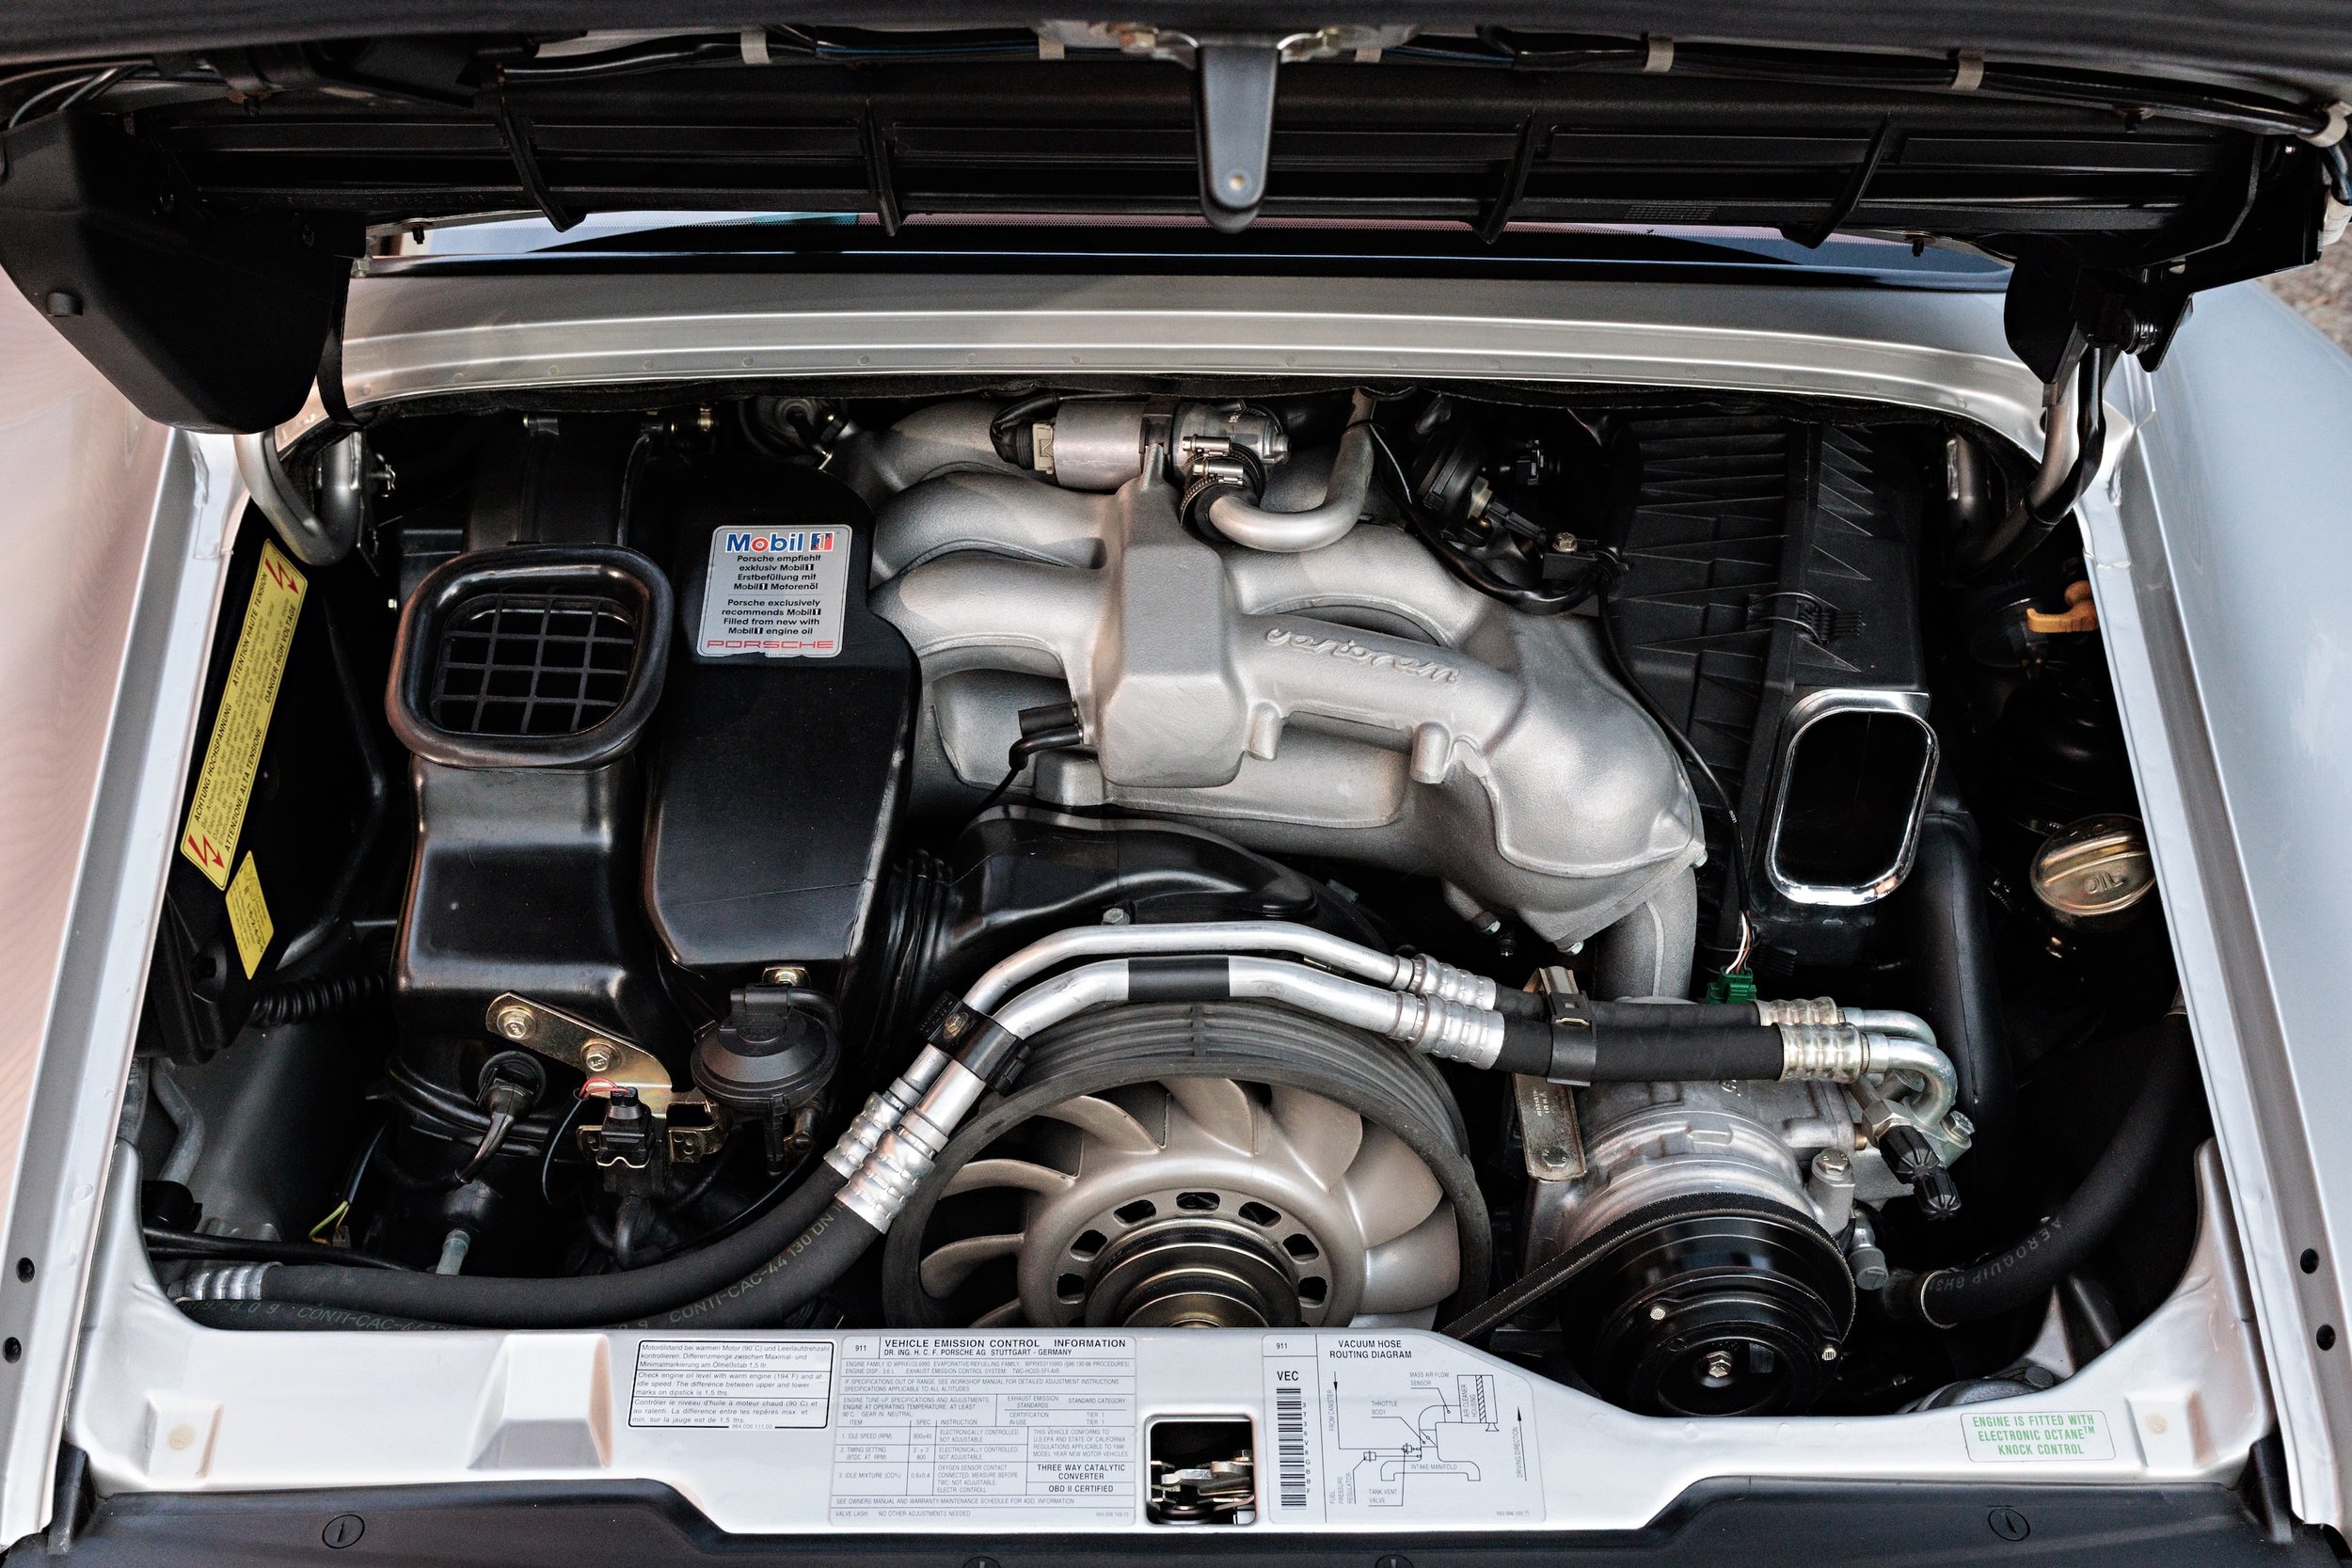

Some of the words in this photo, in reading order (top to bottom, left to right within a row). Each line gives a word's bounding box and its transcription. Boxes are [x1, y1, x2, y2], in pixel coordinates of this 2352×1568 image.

[725, 531, 804, 553] Mobil
[776, 555, 821, 564] empfiehlt
[768, 599, 820, 609] exclusively
[232, 638, 250, 688] ATTENTION
[246, 610, 258, 638] HAUTE
[254, 572, 268, 608] TENSION
[264, 666, 278, 704] DANGER
[275, 641, 285, 666] HIGH
[282, 604, 296, 642] VOLTAGE
[707, 641, 834, 649] PORSCHE
[1264, 628, 1460, 684] varioram
[194, 777, 211, 823] ACHTUNG
[207, 703, 232, 778] HOCHSPANNUNG
[225, 796, 244, 852] ATTENZIONE
[240, 771, 250, 795] ALTA
[246, 726, 262, 771] TENSIONE
[2084, 873, 2124, 895] OIL
[1973, 1216, 2062, 1285] AEROQUIP
[668, 1256, 788, 1323] CONTI-CAC-44
[789, 1233, 812, 1258] 130
[811, 1212, 835, 1237] DN
[1277, 1371, 1299, 1381] VEC
[1460, 1384, 1469, 1406] CLEANER
[1972, 1417, 2010, 1427] ENGINE
[2014, 1416, 2025, 1426] IS
[2029, 1415, 2064, 1426] FITTED
[2068, 1415, 2094, 1425] WITH
[1512, 1427, 1521, 1454] DIRECTION
[1978, 1430, 2041, 1442] ELECTRONIC
[1998, 1445, 2033, 1455] KNOCK
[2037, 1444, 2084, 1455] CONTROL
